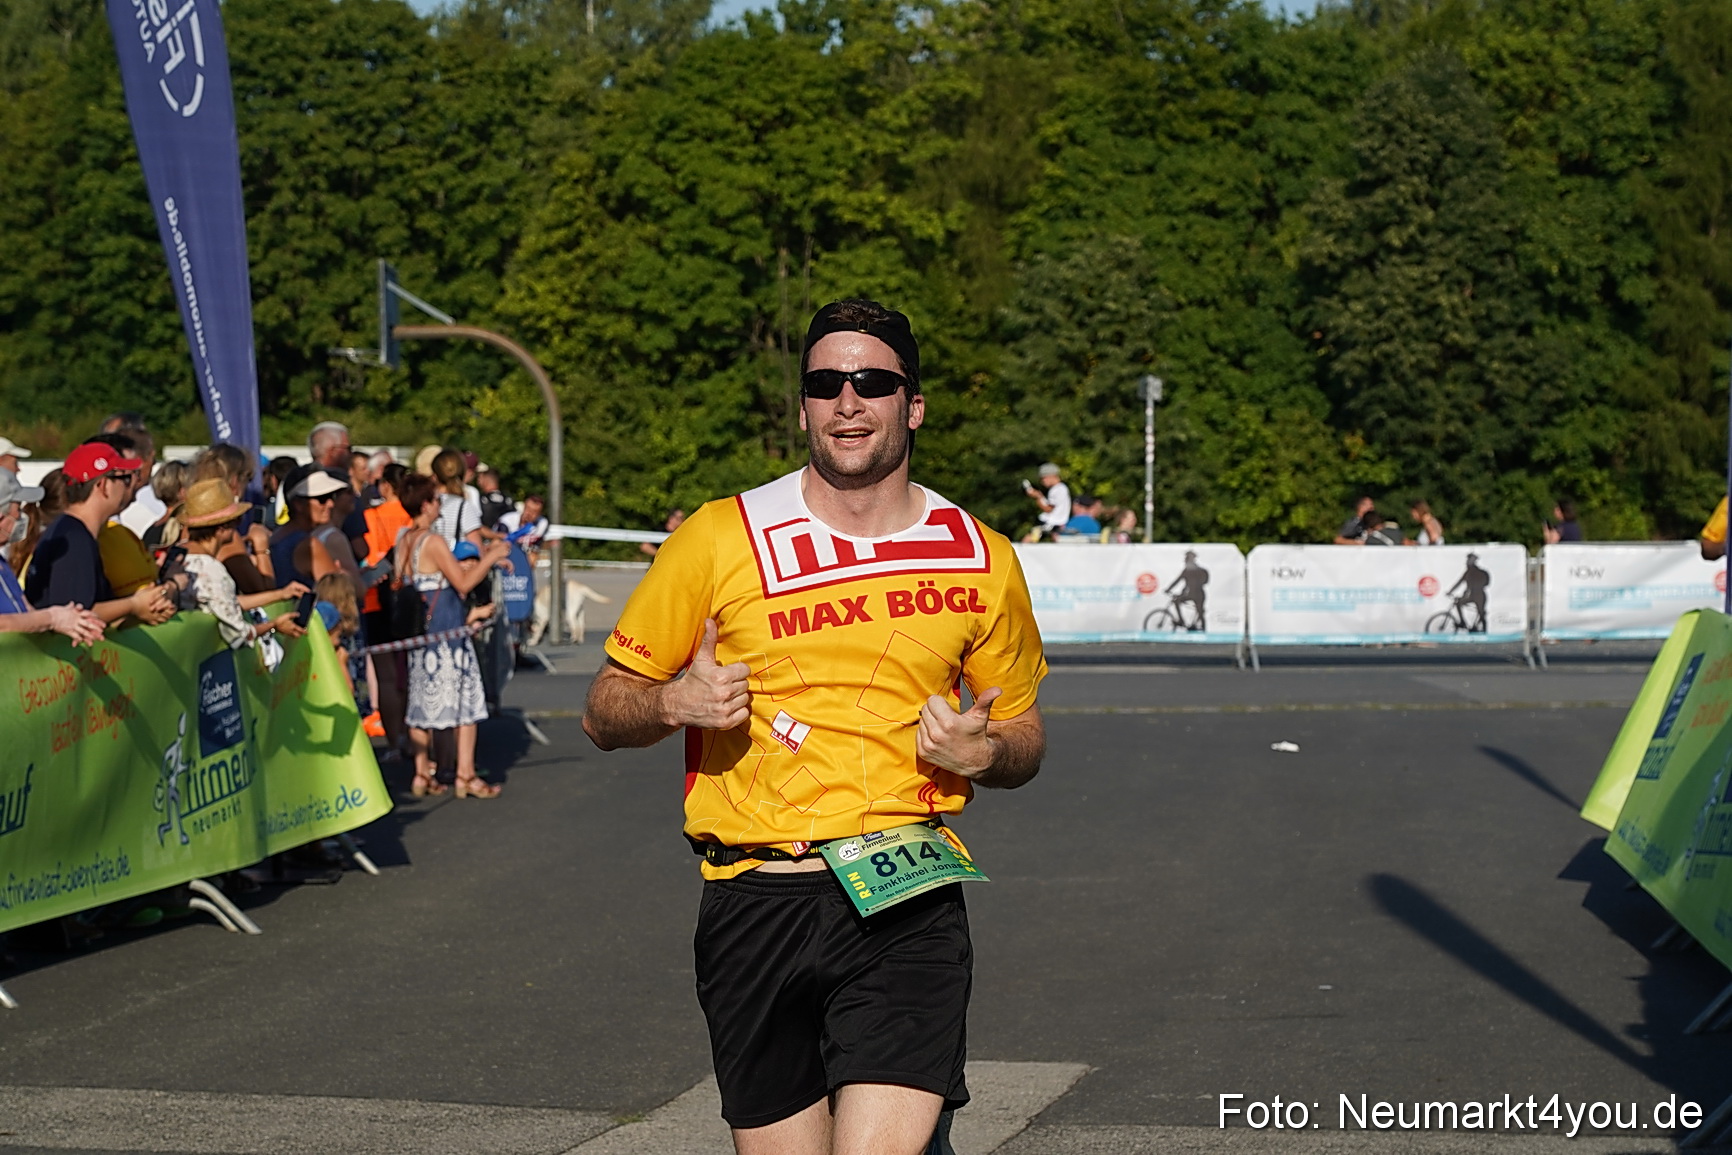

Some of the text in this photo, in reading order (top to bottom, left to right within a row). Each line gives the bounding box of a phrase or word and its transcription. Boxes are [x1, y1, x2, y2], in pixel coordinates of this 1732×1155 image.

[768, 580, 987, 640] MAX BÖGL
[861, 833, 901, 850] Firmenlauf
[870, 841, 942, 877] 814
[847, 871, 872, 899] RUN
[869, 866, 929, 895] Fankhänel
[931, 863, 964, 872] Jonas
